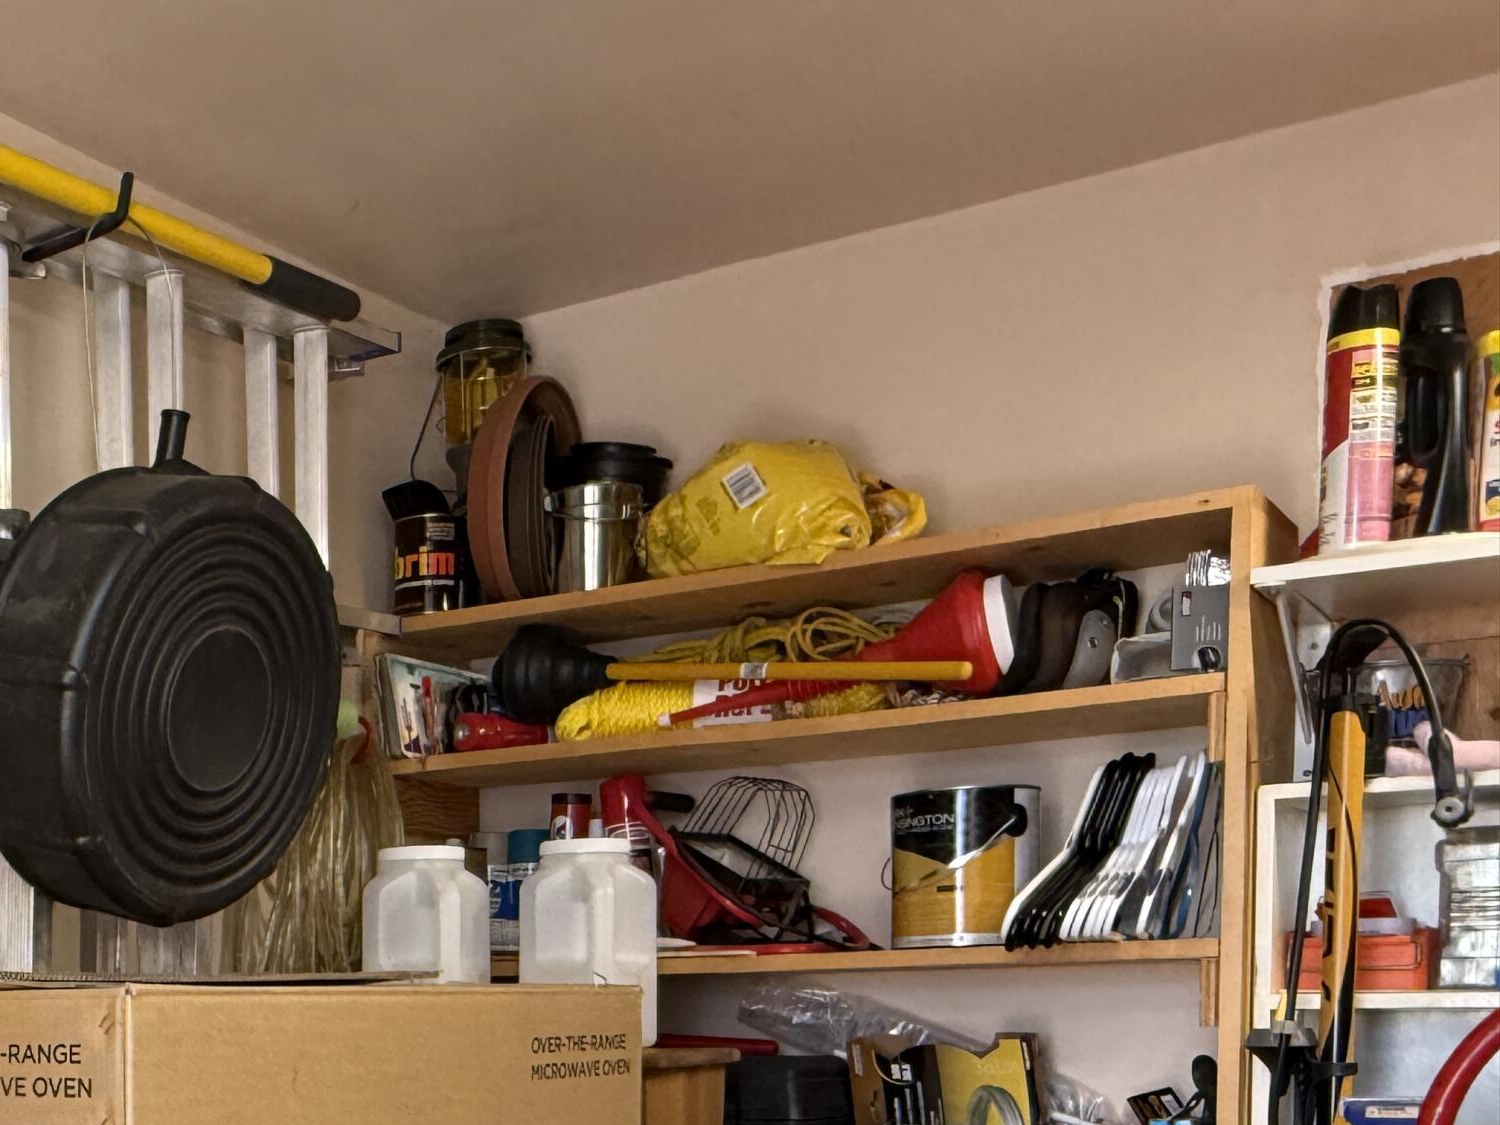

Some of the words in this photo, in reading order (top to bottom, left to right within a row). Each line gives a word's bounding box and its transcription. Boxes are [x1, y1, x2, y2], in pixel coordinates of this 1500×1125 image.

[531, 1033, 627, 1054] OVER-THE-RANGE
[531, 1060, 600, 1082] MICROWAVE
[602, 1059, 631, 1076] OVEN
[32, 1076, 92, 1099] OVEN
